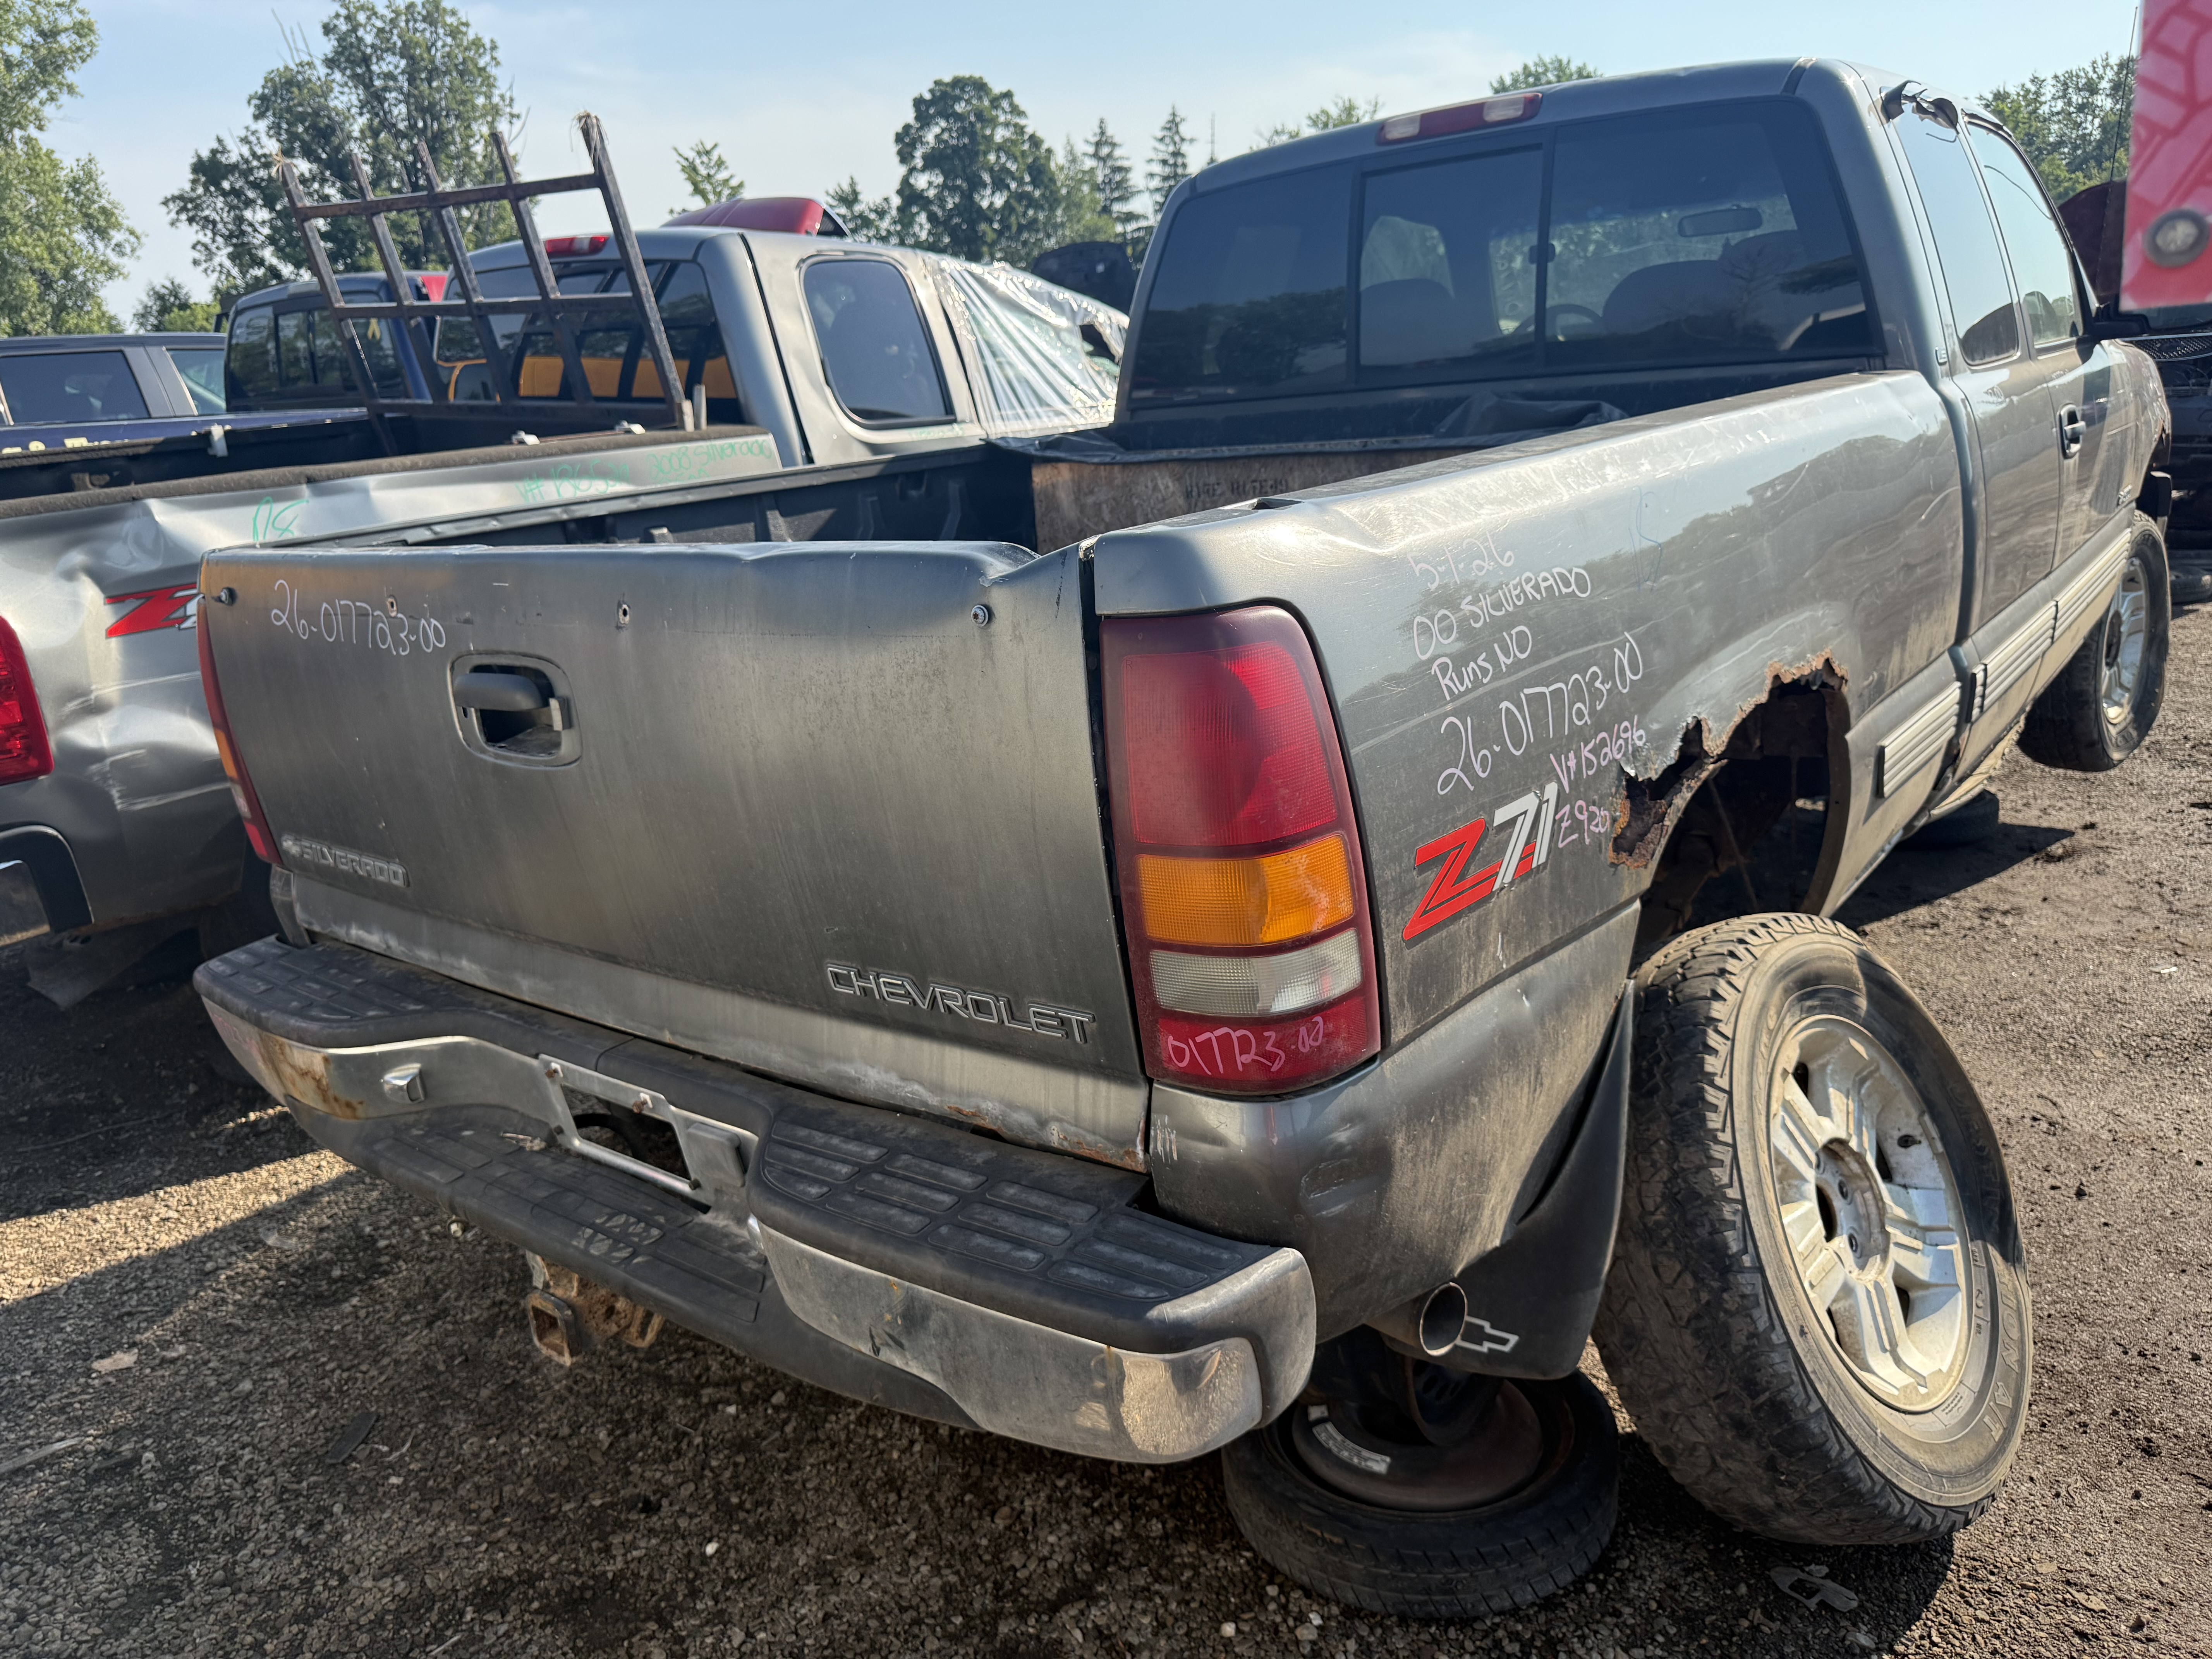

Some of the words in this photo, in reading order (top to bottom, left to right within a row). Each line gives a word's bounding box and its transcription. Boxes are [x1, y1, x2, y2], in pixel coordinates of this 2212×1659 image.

[1413, 609, 1456, 659] 00
[1461, 567, 1590, 627] SILVERADO
[1126, 659, 1133, 670] R
[300, 837, 410, 887] SILVERADO
[1402, 781, 1559, 941] Z71
[827, 963, 1096, 1043] CHEVROLET
